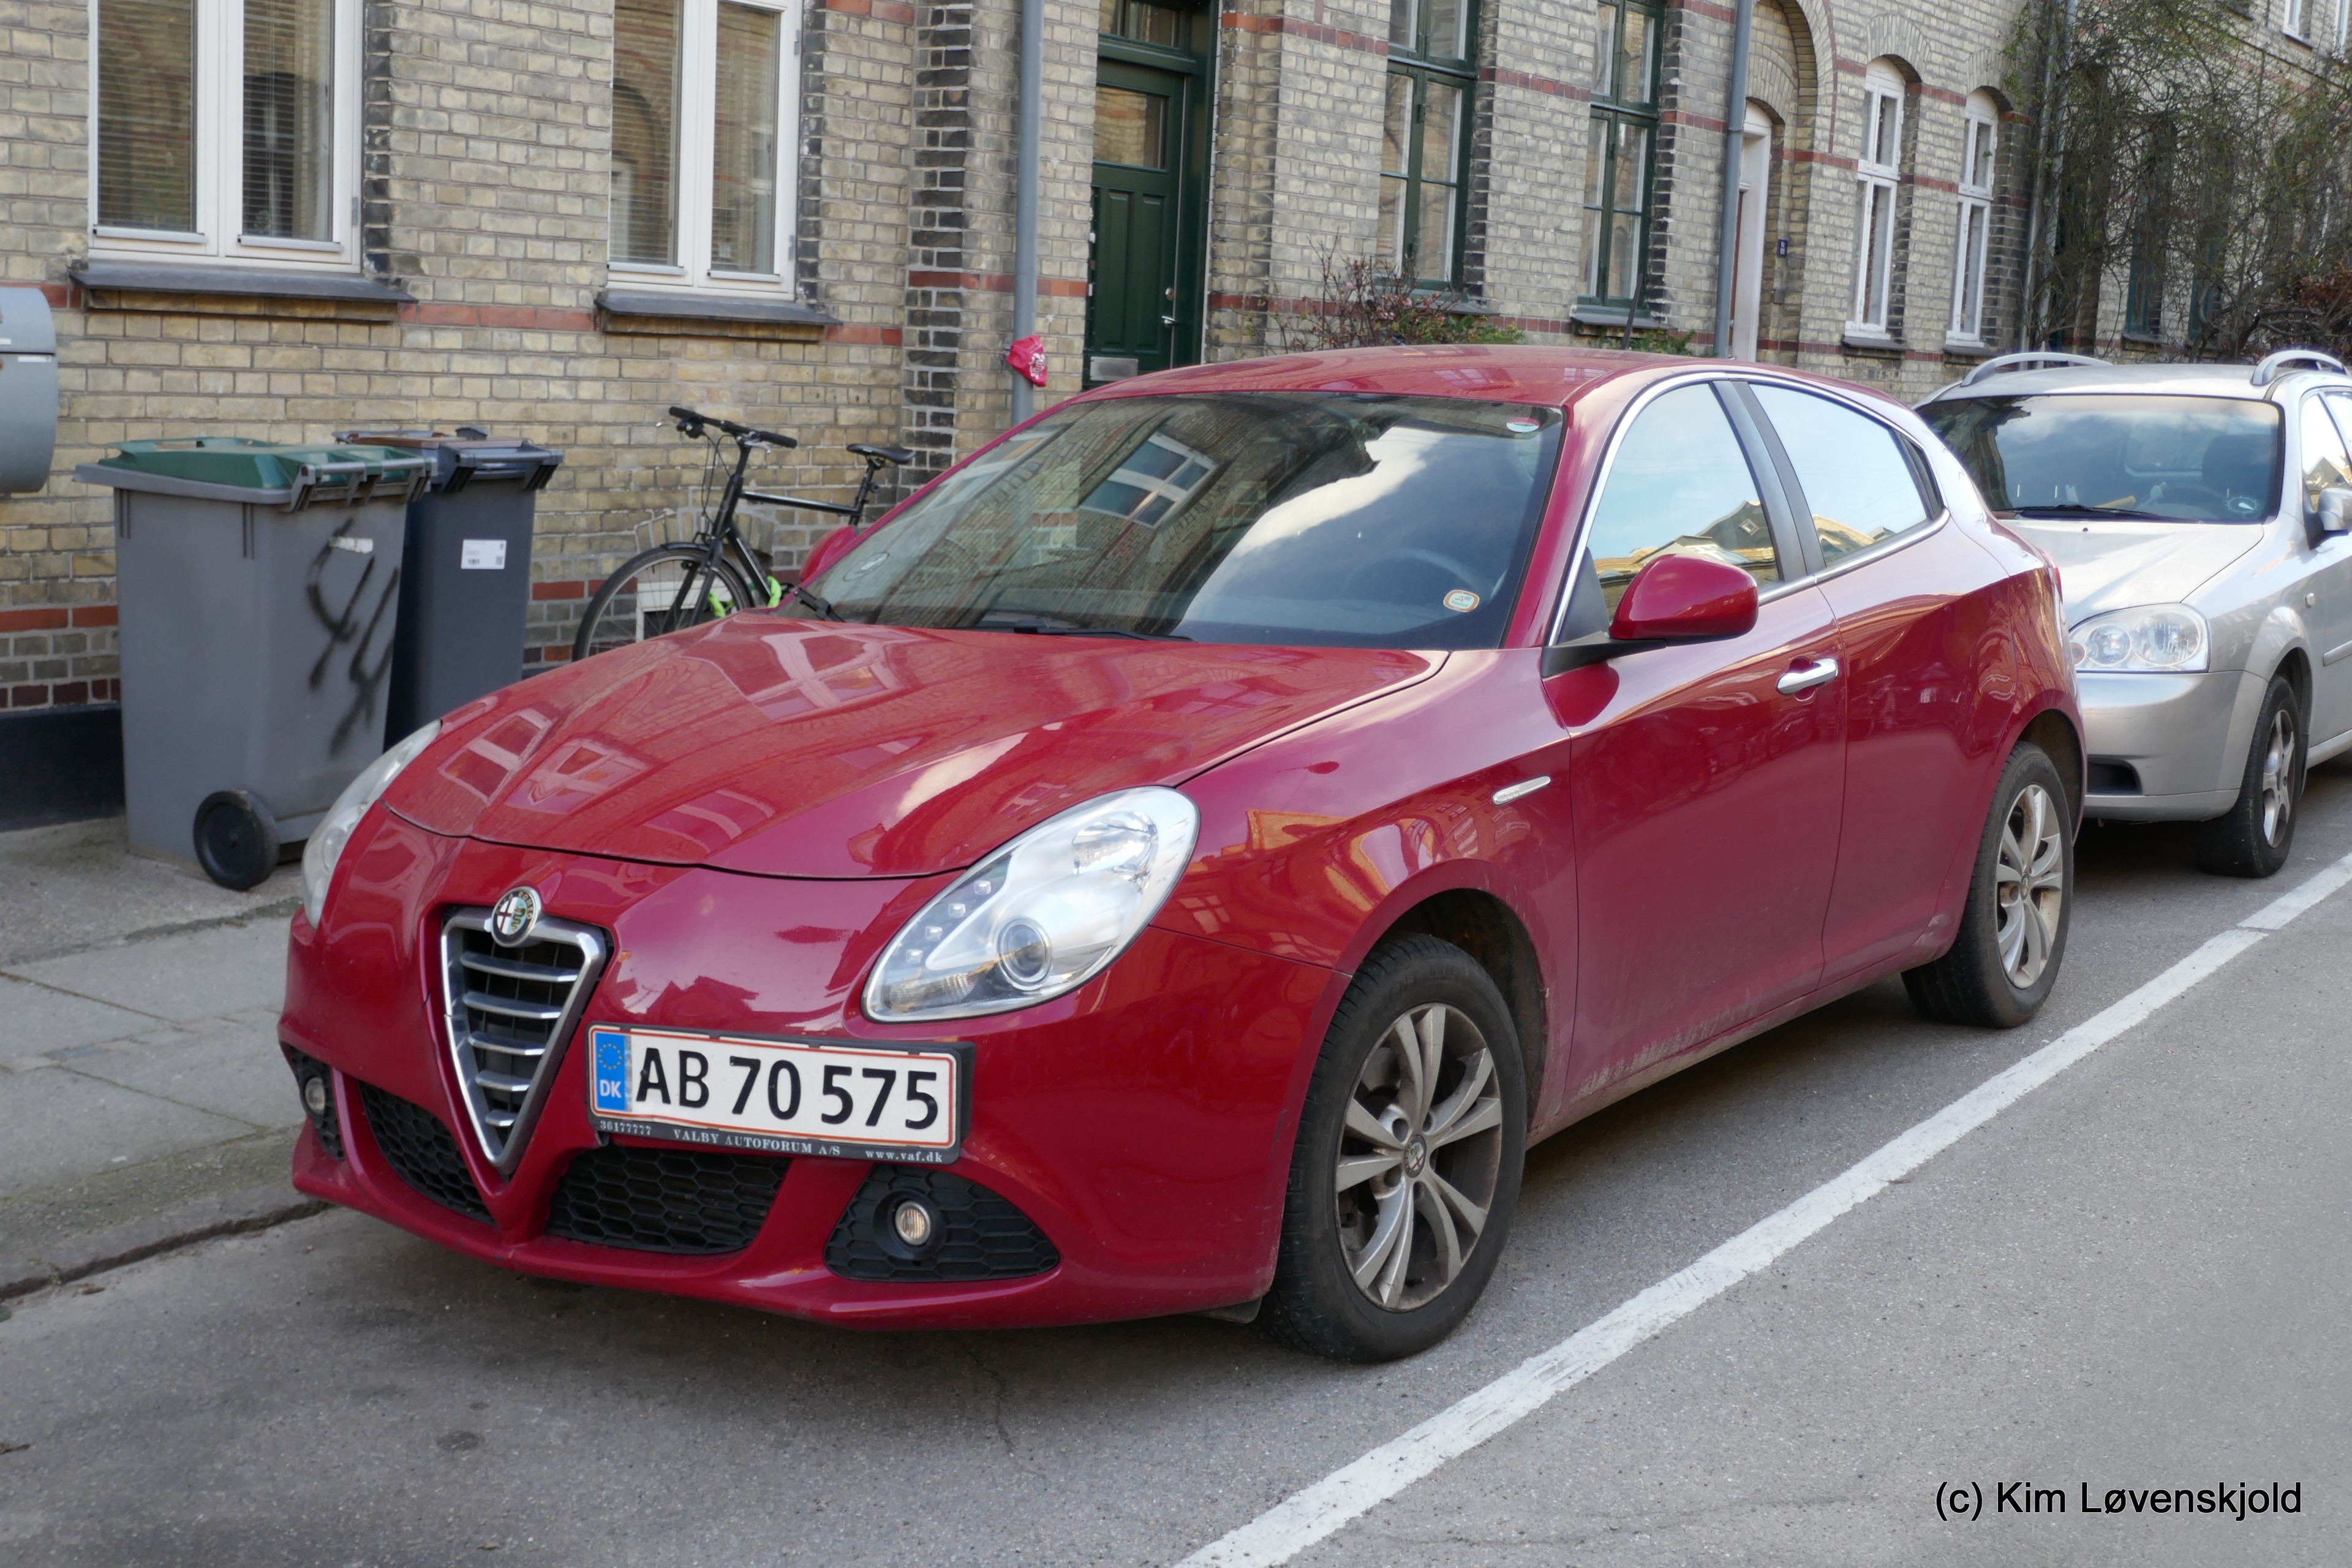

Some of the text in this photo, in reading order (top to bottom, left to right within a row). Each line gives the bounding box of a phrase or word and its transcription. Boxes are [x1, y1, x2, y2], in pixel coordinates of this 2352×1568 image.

[600, 1079, 622, 1098] DK
[636, 1047, 938, 1130] AB 70 575
[600, 1120, 943, 1163] 36177777 VALBY AUTOFORUM A/S www.vaf.dk
